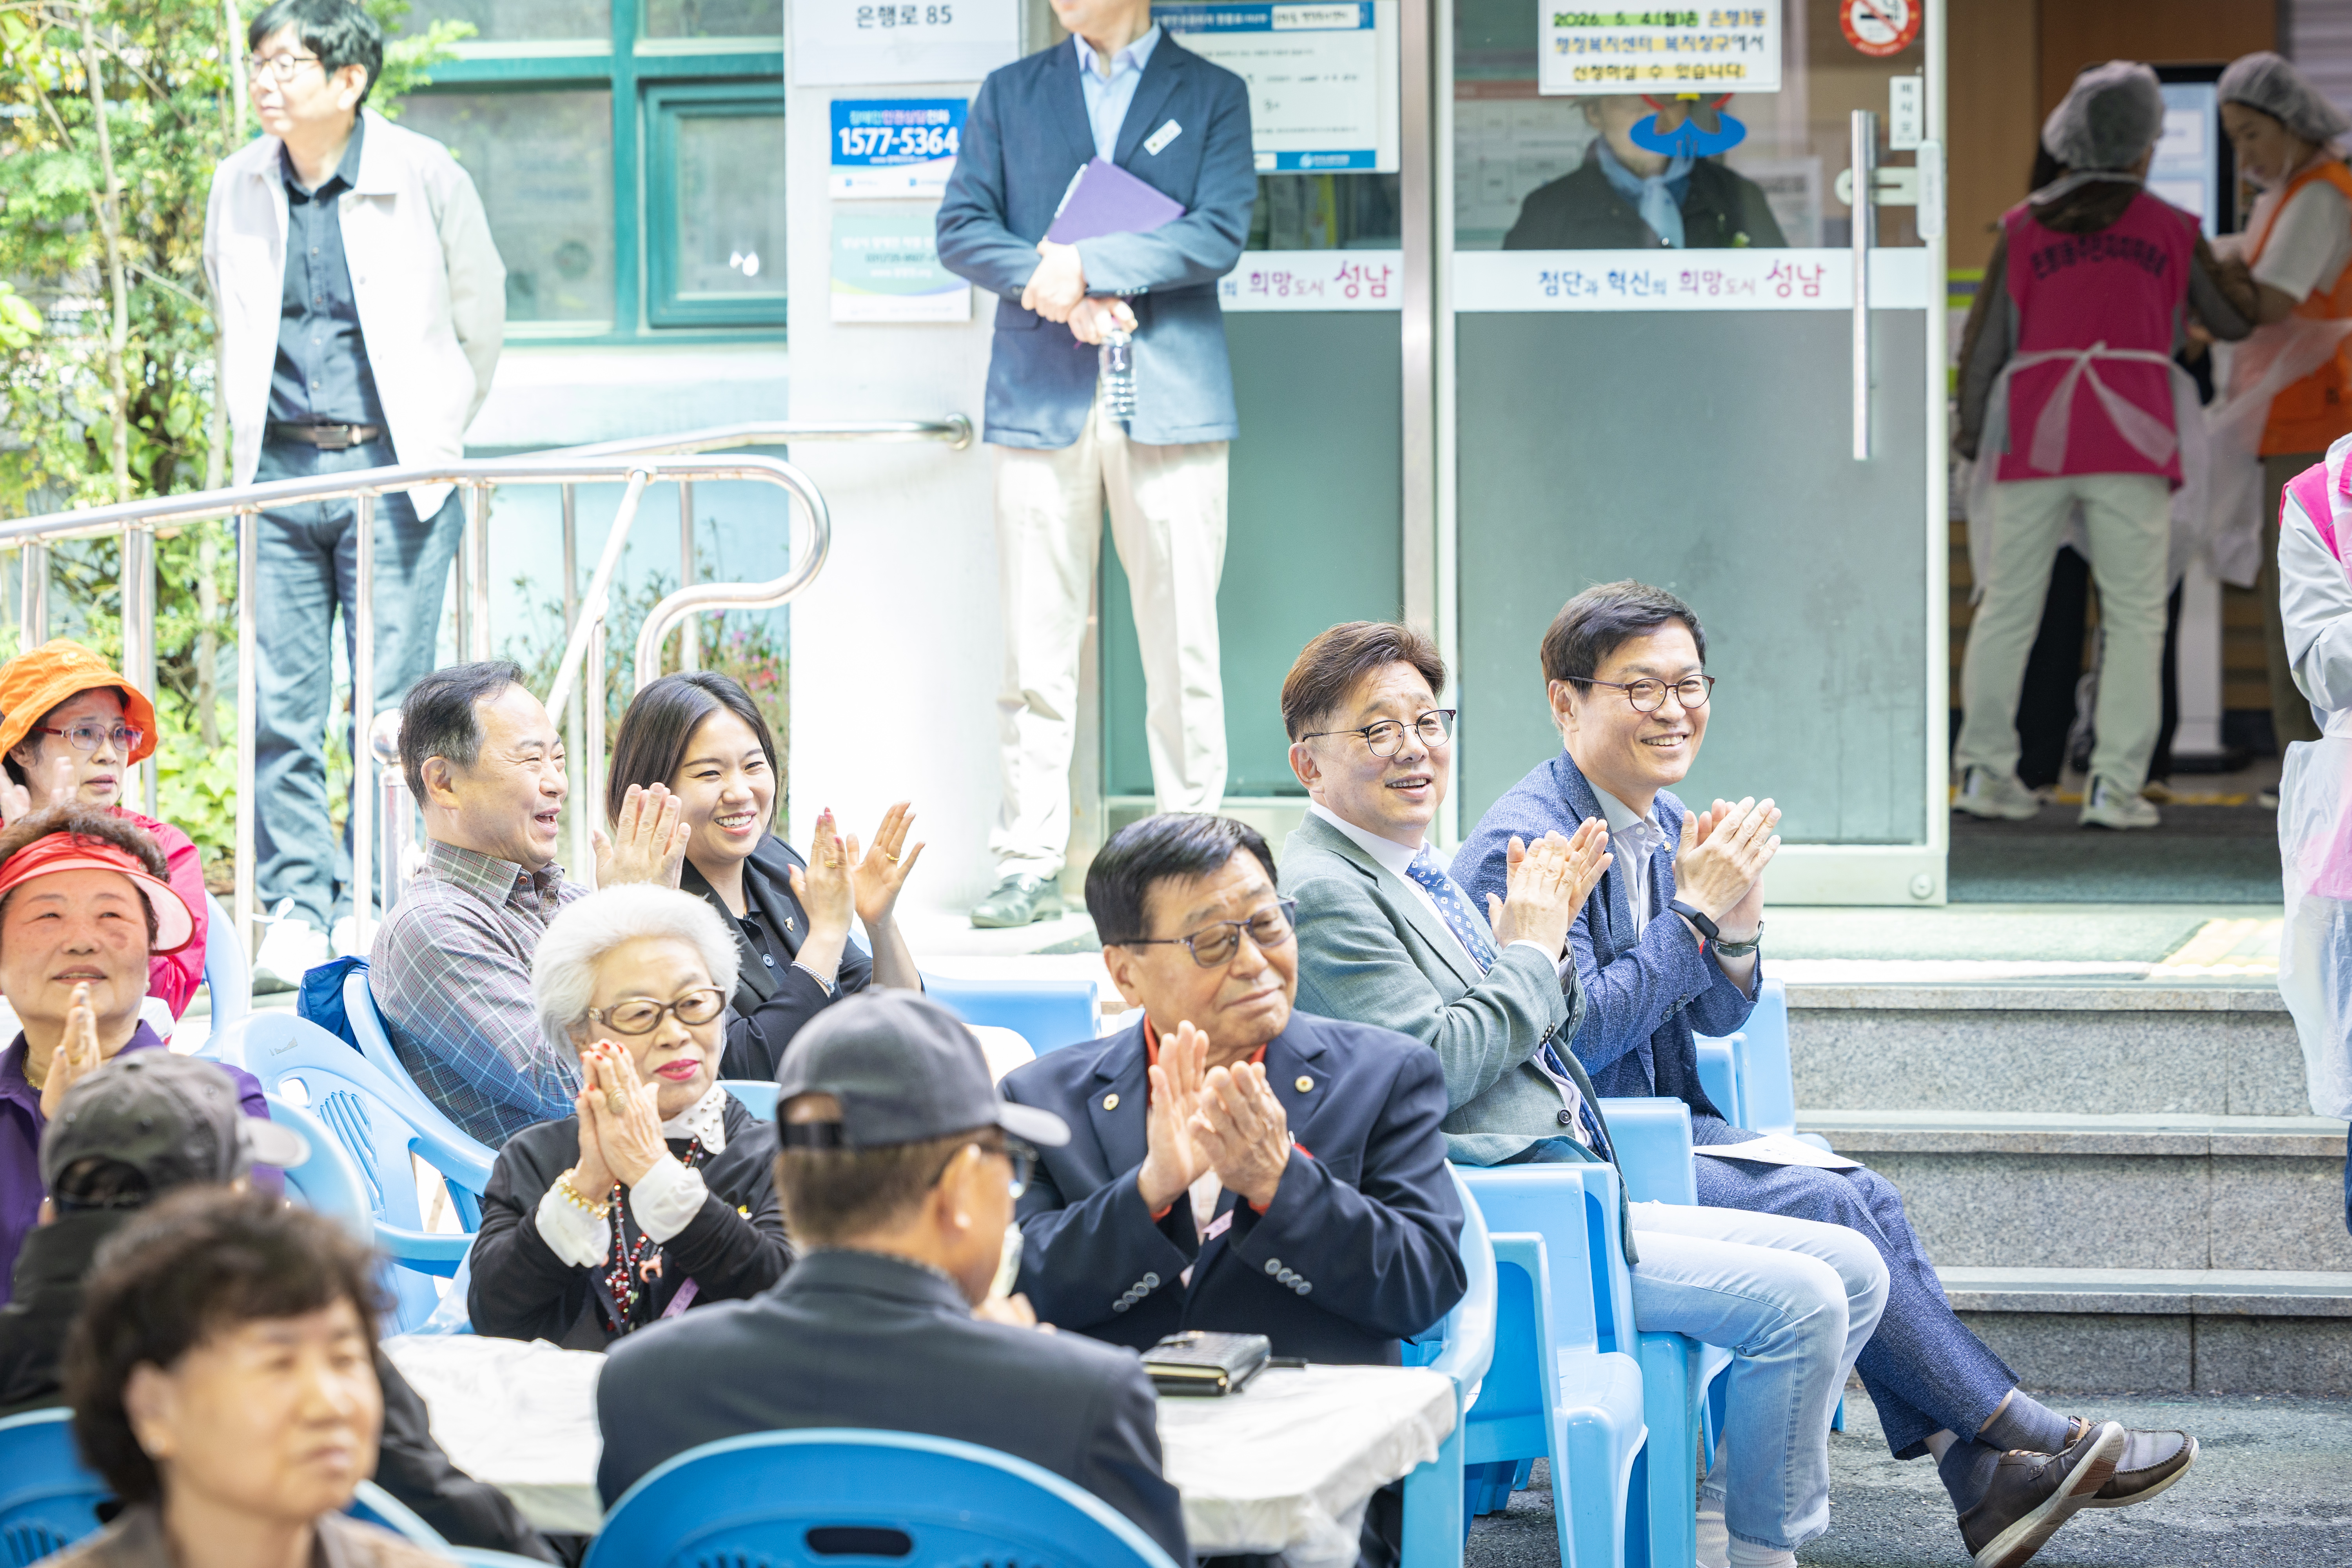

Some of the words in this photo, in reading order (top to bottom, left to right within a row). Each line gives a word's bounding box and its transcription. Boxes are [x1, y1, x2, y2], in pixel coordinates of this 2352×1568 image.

[856, 5, 918, 28] 은행로
[926, 5, 952, 25] 85
[1554, 12, 1604, 27] 2026.
[1708, 9, 1766, 28] 은행1동
[1555, 35, 1653, 54] 행정복지센터
[1665, 34, 1764, 53] 복지창구에서
[1573, 64, 1637, 81] 신청하실
[1649, 63, 1663, 79] 수
[838, 127, 960, 156] 1577-5364
[1249, 269, 1325, 297] 희망도시
[1334, 260, 1393, 298] 성남
[1539, 270, 1599, 297] 첨단과
[1607, 269, 1667, 297] 혁신의
[1678, 269, 1756, 297] 희망도시
[1766, 260, 1825, 298] 성남
